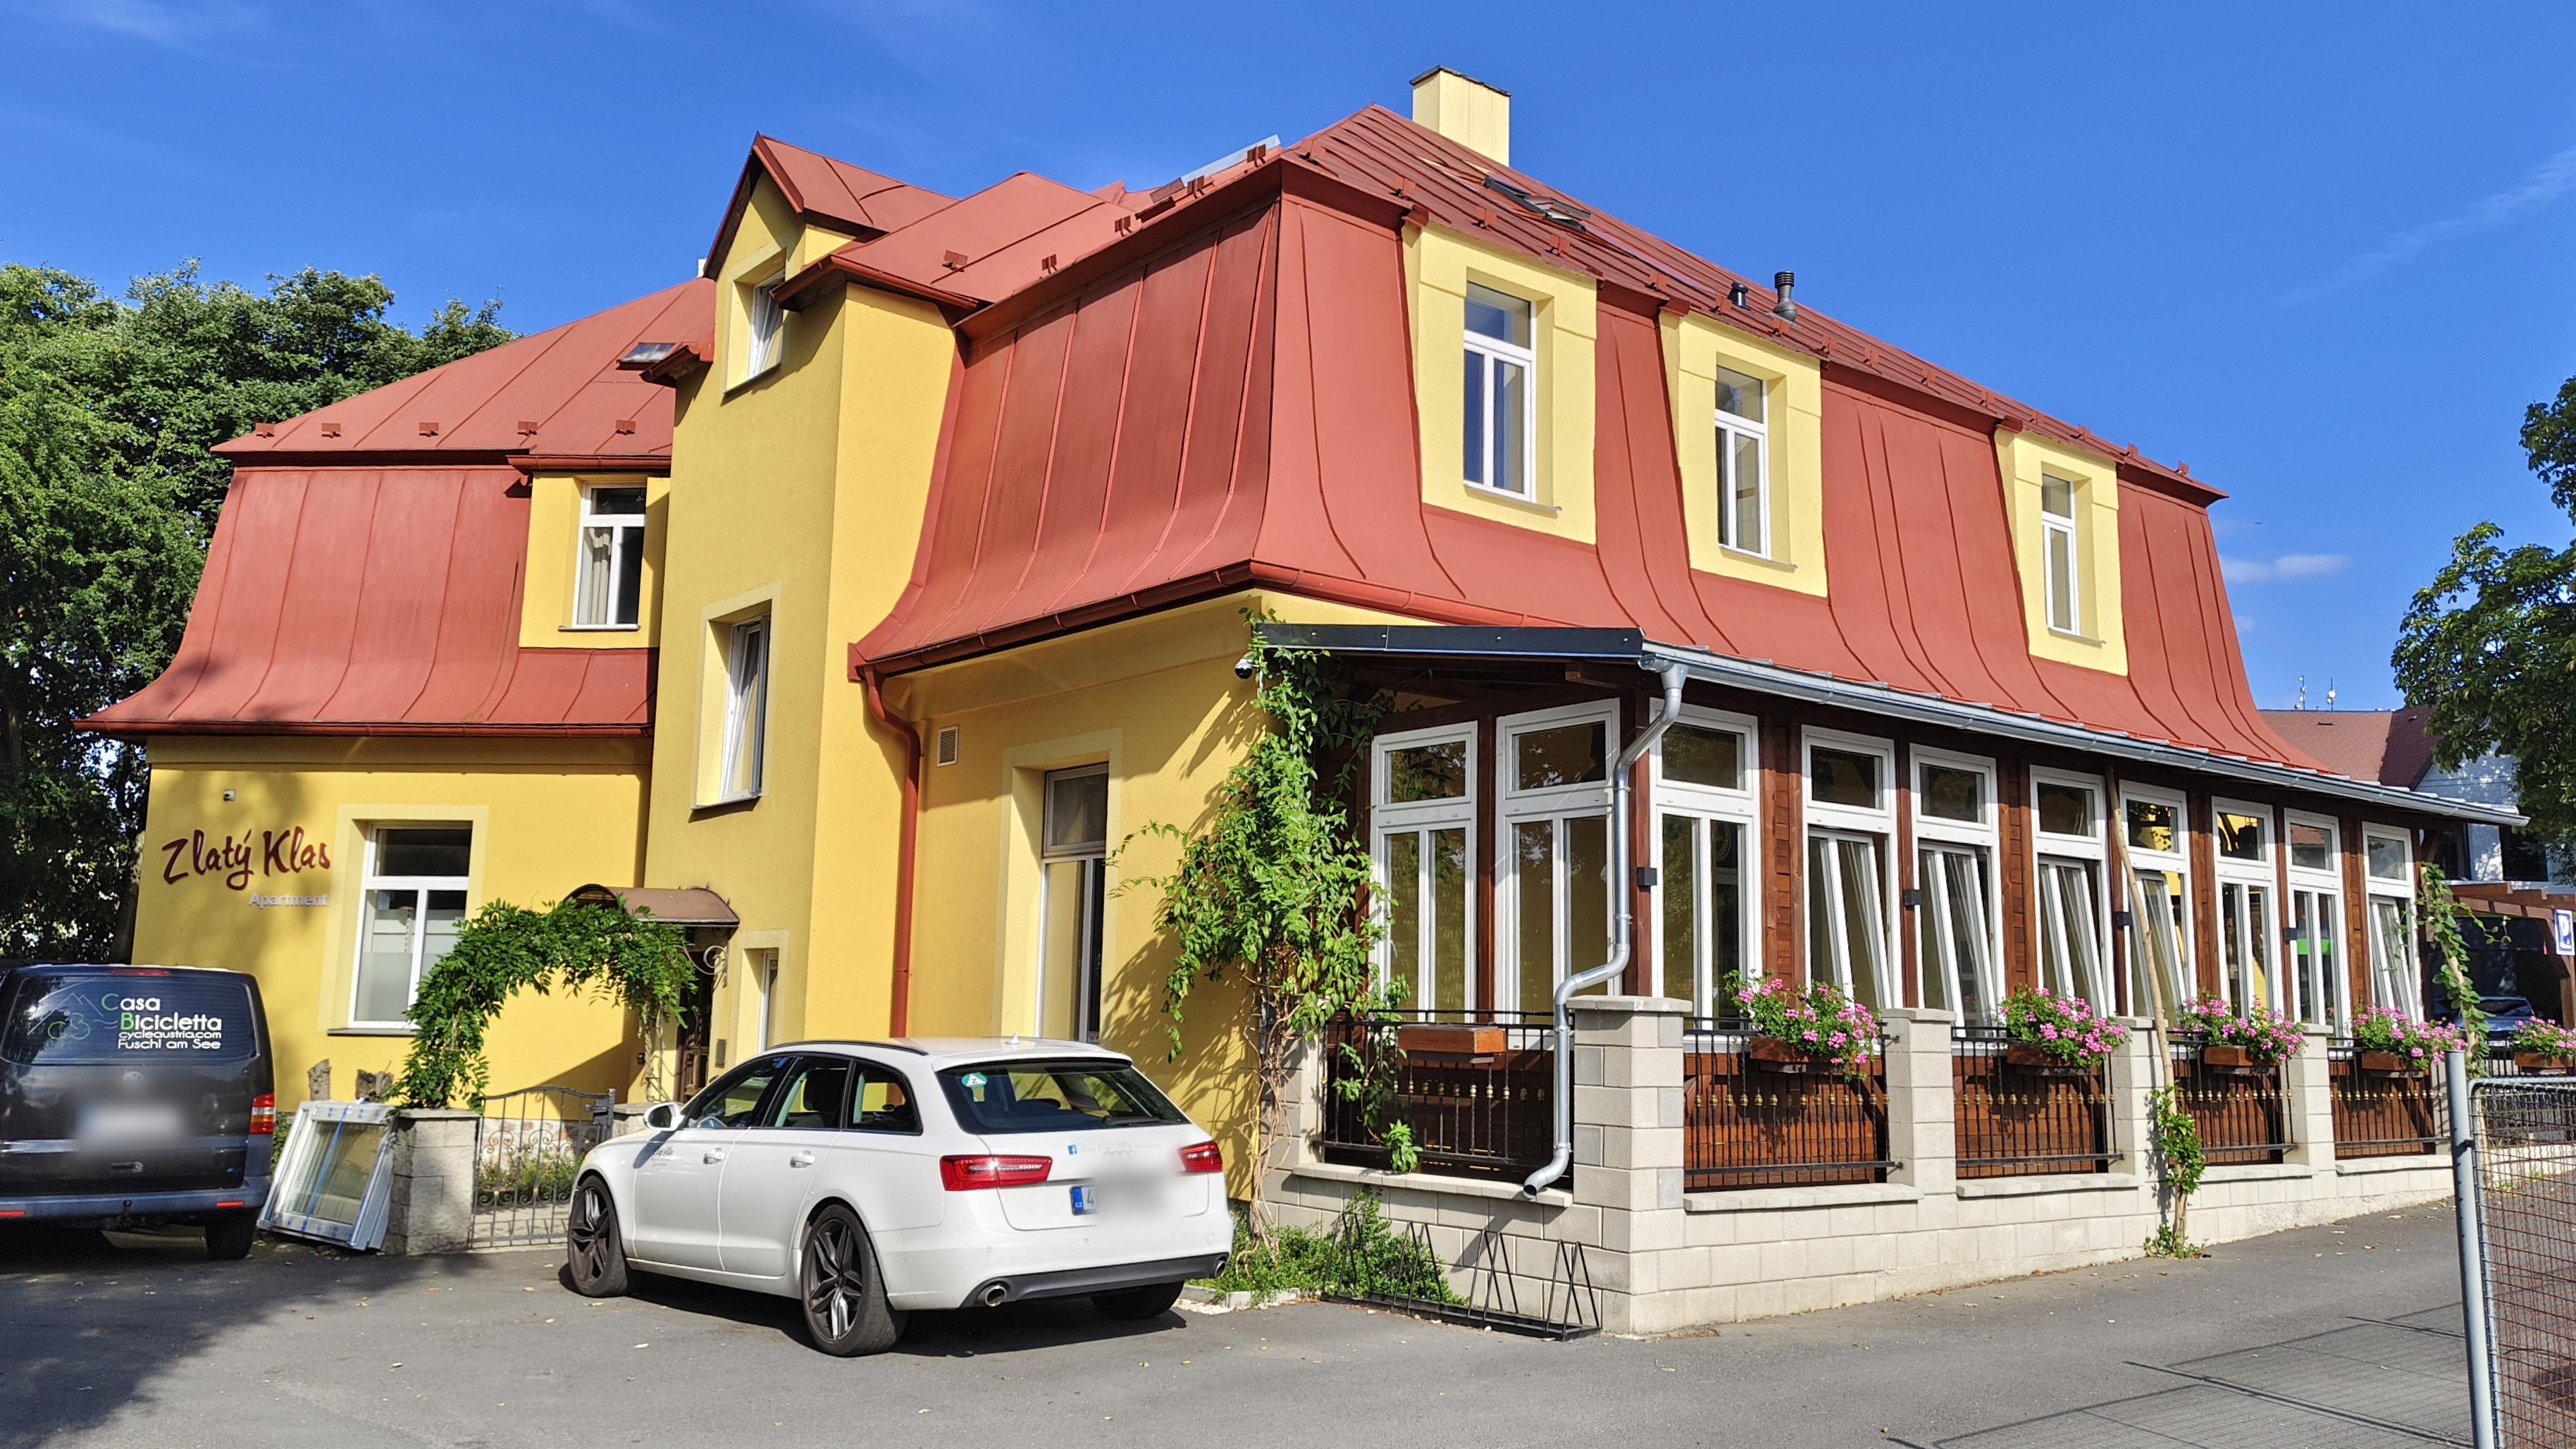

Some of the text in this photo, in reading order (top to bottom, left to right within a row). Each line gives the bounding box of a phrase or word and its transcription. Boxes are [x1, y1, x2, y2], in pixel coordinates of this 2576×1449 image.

[161, 826, 331, 891] Zlatý Klas
[248, 893, 328, 909] Apartment
[2558, 915, 2570, 943] P
[101, 993, 161, 1011] Casa
[120, 1011, 223, 1031] Bicicletta
[118, 1030, 222, 1040] cycleaustria.com
[118, 1039, 221, 1049] Fuschl am See
